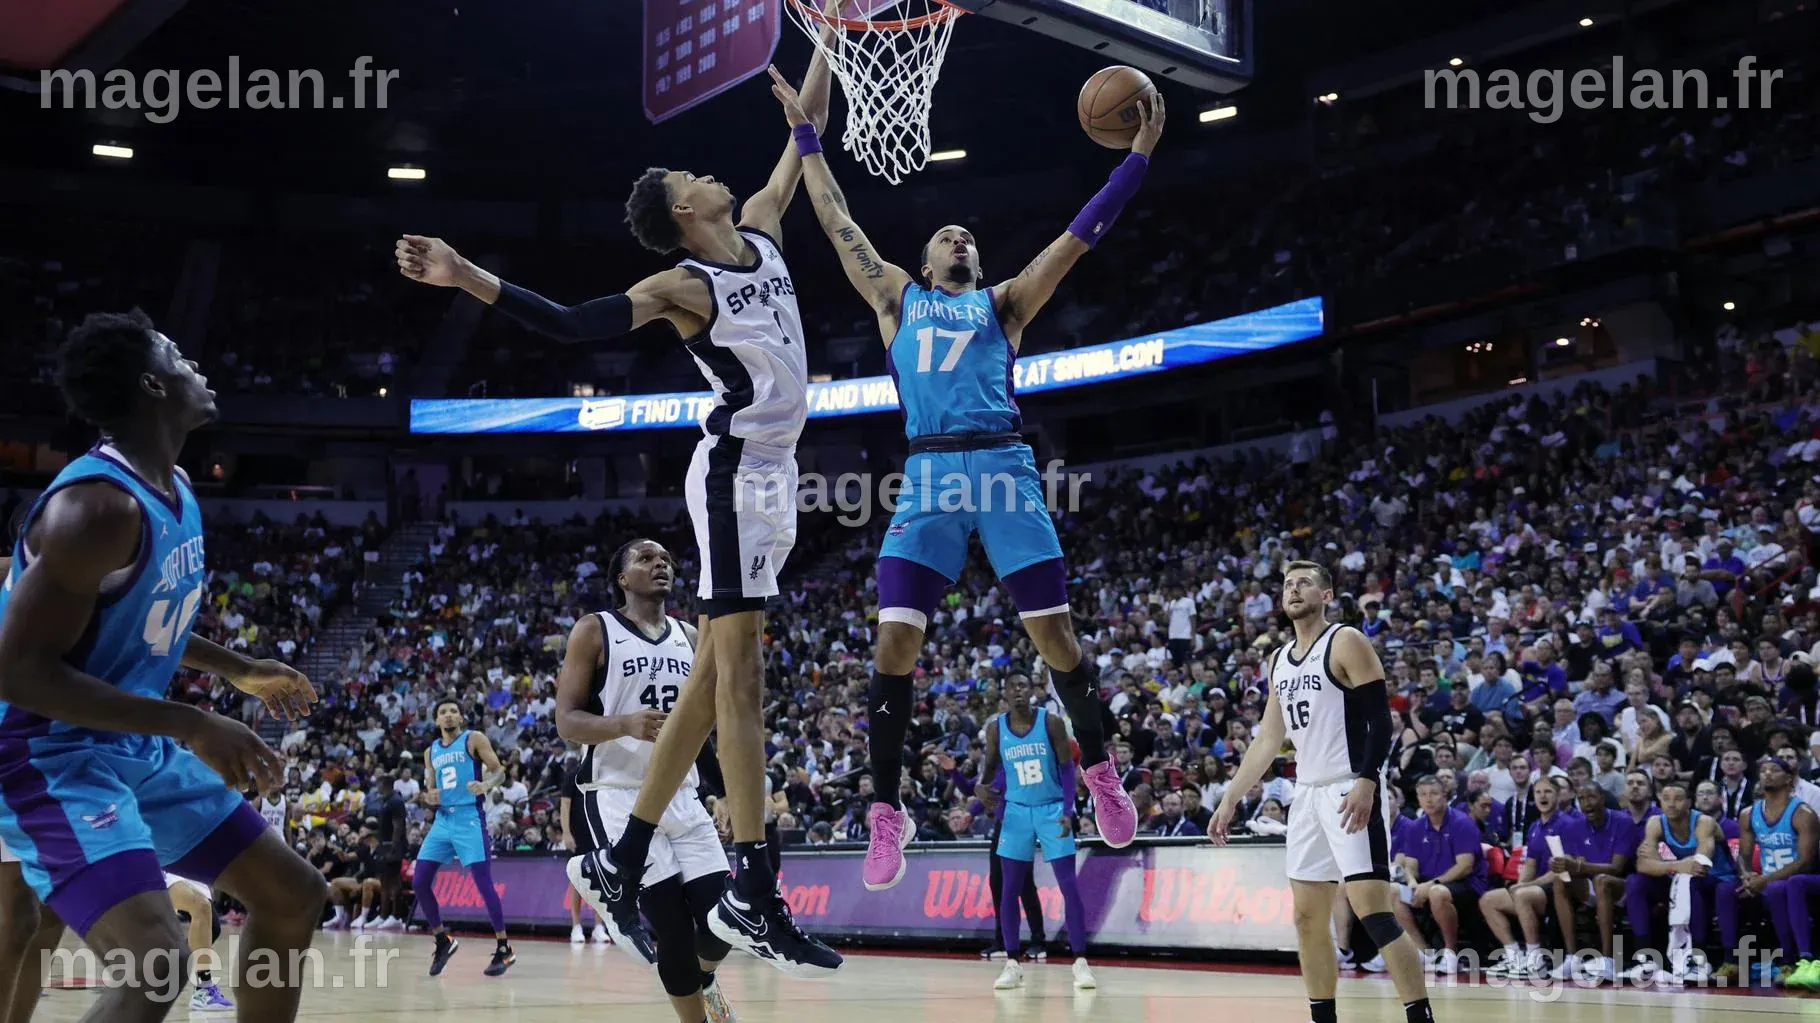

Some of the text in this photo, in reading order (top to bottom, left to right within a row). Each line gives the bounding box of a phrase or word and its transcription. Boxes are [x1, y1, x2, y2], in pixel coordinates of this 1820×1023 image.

[836, 226, 854, 242] No
[907, 299, 988, 327] HORNETS
[916, 326, 977, 373] 17
[631, 398, 681, 425] FIND
[815, 383, 859, 412] AND
[1024, 359, 1052, 386] AT
[622, 656, 691, 681] SPURS
[639, 684, 679, 714] 42
[1286, 700, 1310, 731] 16
[1005, 742, 1047, 761] HORNETS
[441, 766, 457, 790] 2
[1013, 758, 1043, 787] 18
